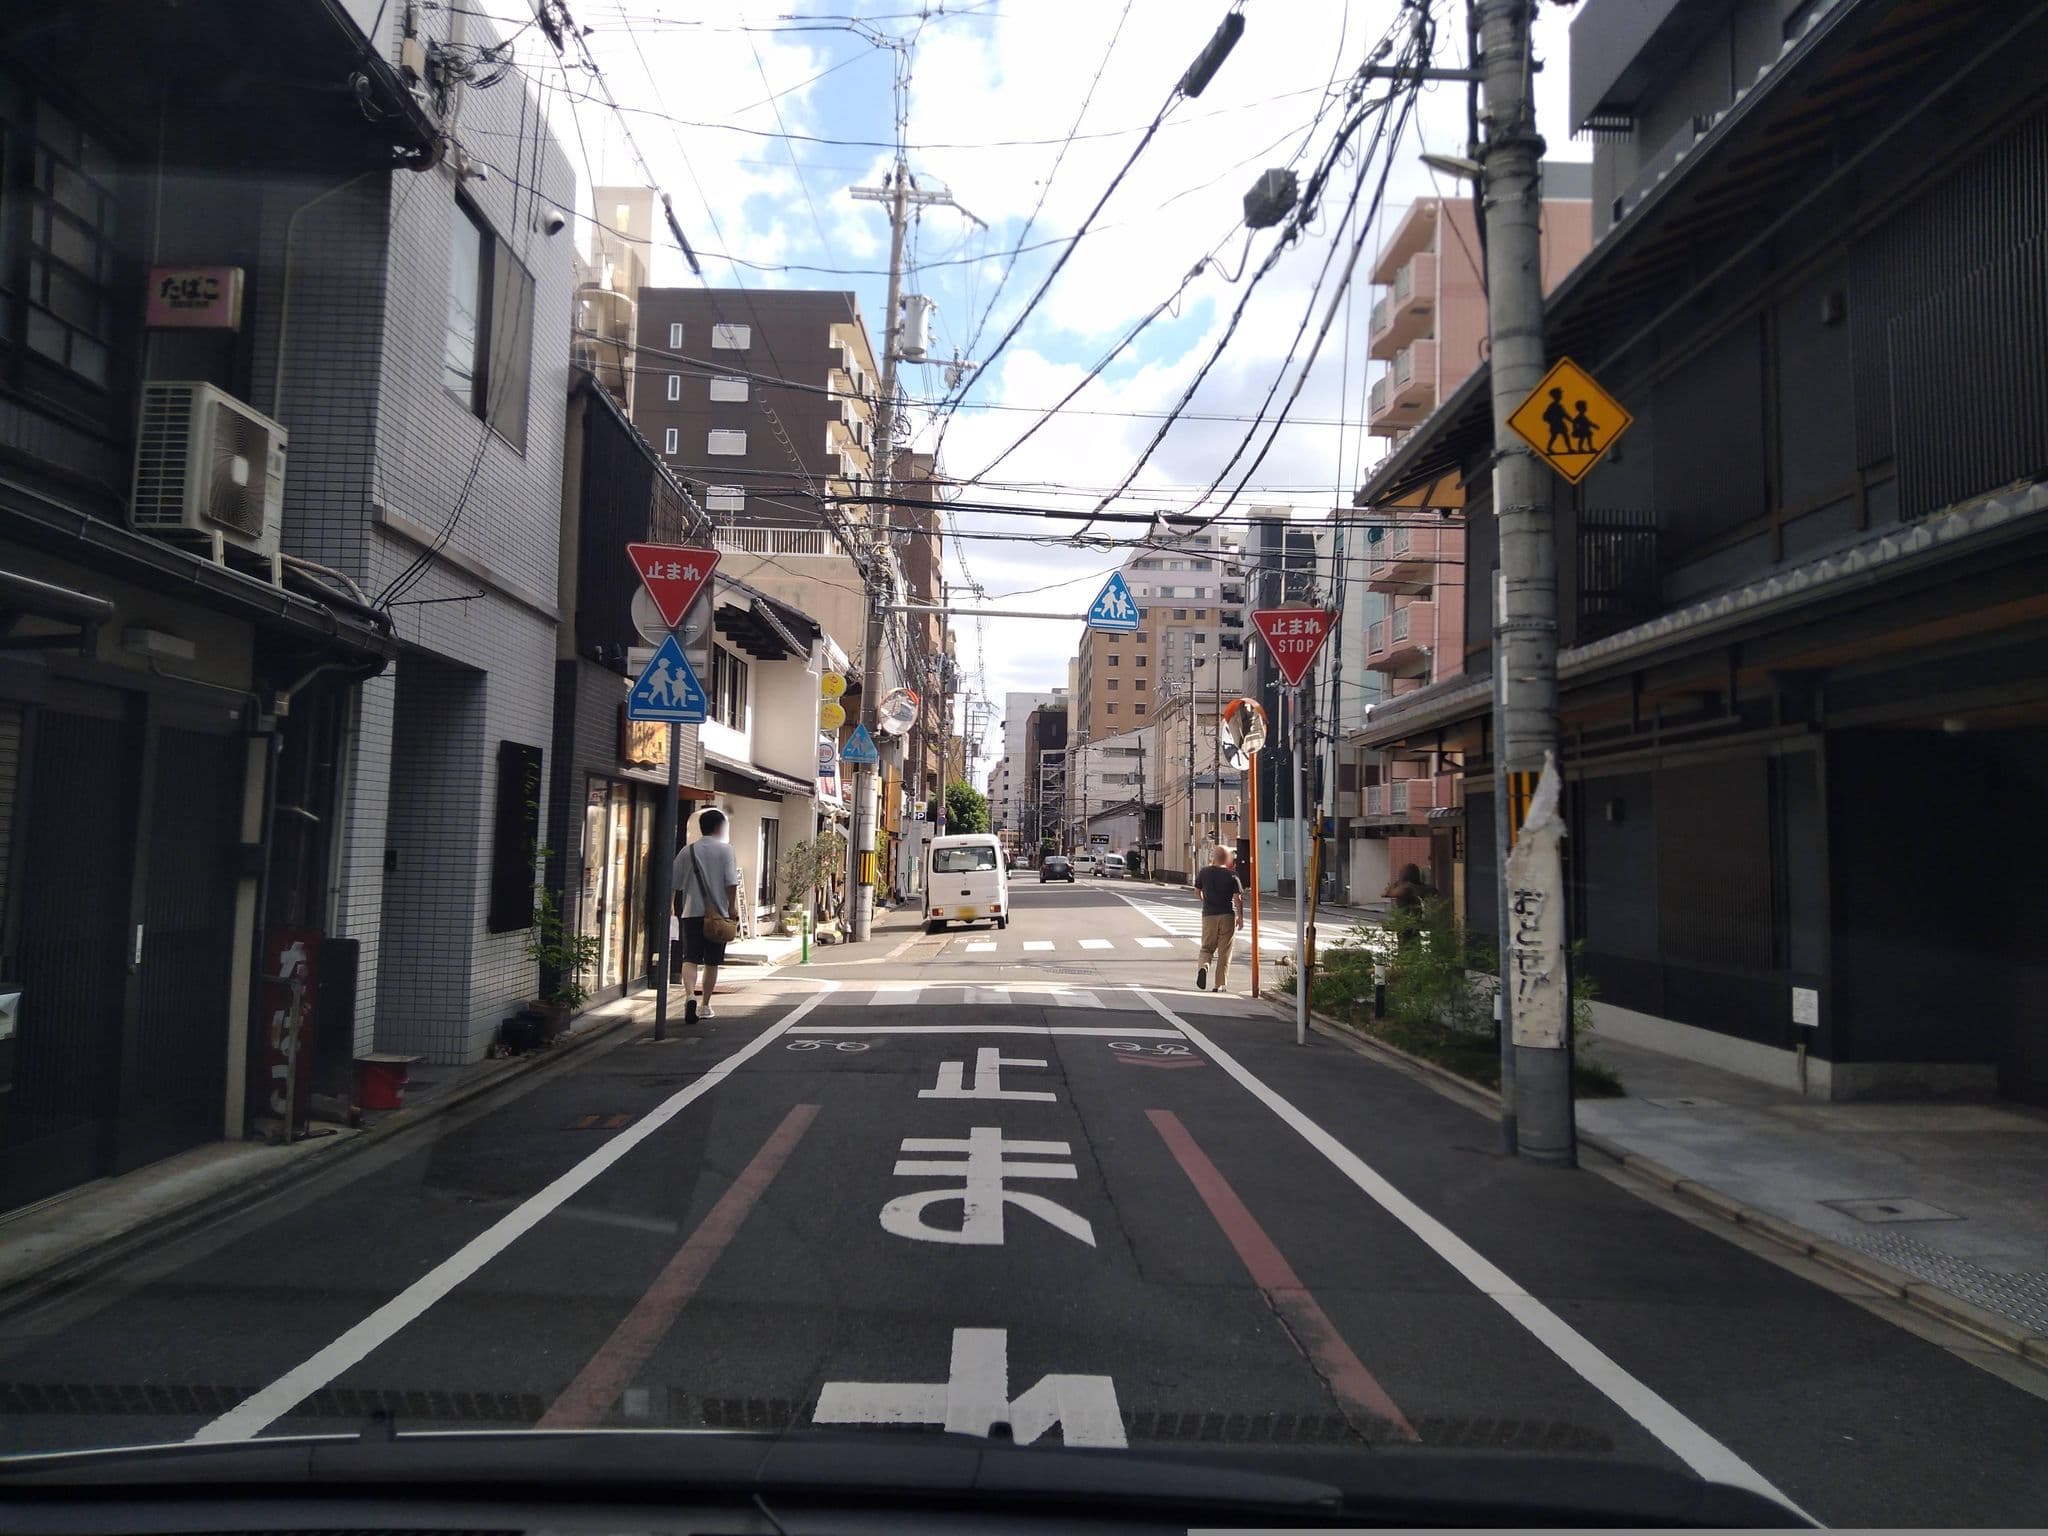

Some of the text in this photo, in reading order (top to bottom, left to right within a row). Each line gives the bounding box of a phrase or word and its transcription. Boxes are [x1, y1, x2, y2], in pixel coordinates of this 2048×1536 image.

[161, 277, 219, 299] たばこ
[646, 561, 701, 581] 止まれ
[1270, 617, 1322, 635] 止まれ
[1279, 639, 1314, 653] STOP
